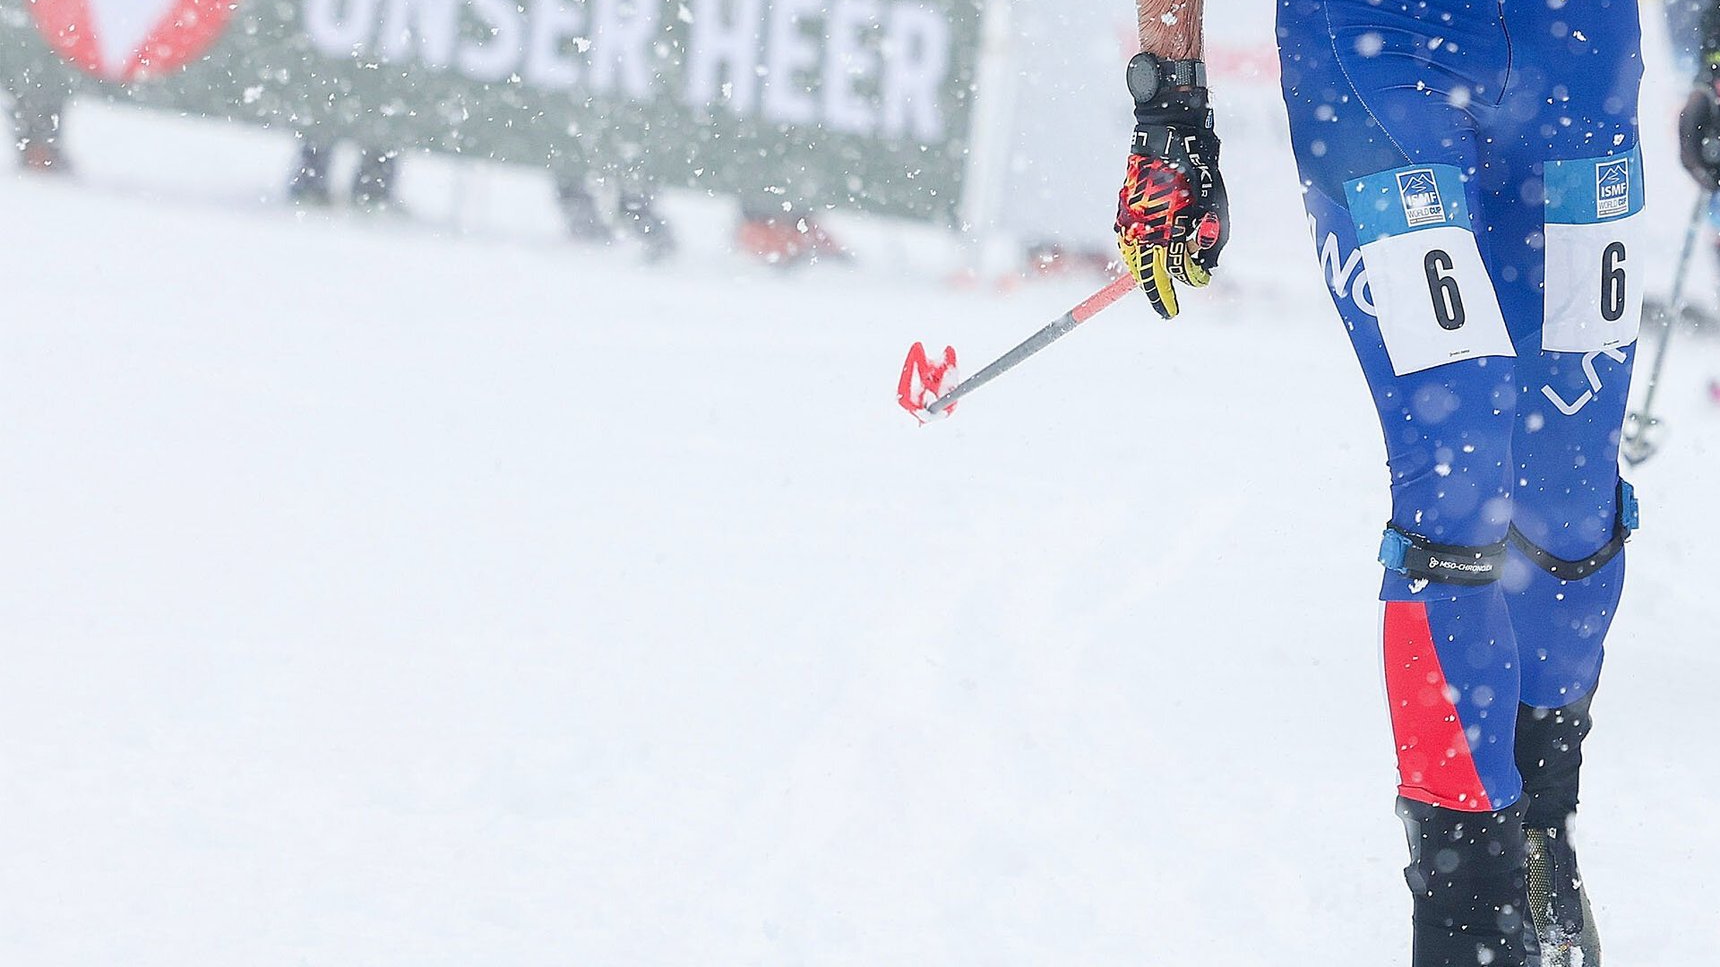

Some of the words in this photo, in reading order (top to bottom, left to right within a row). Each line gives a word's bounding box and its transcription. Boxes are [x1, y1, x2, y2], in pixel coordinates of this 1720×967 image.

[1184, 136, 1212, 189] LEKI
[1601, 182, 1627, 198] ISMF
[1407, 207, 1430, 218] WORLD
[1429, 206, 1442, 215] CUP
[1600, 200, 1617, 210] WORLD
[1172, 215, 1188, 237] LA
[1424, 249, 1466, 330] 6
[1600, 241, 1626, 322] 6
